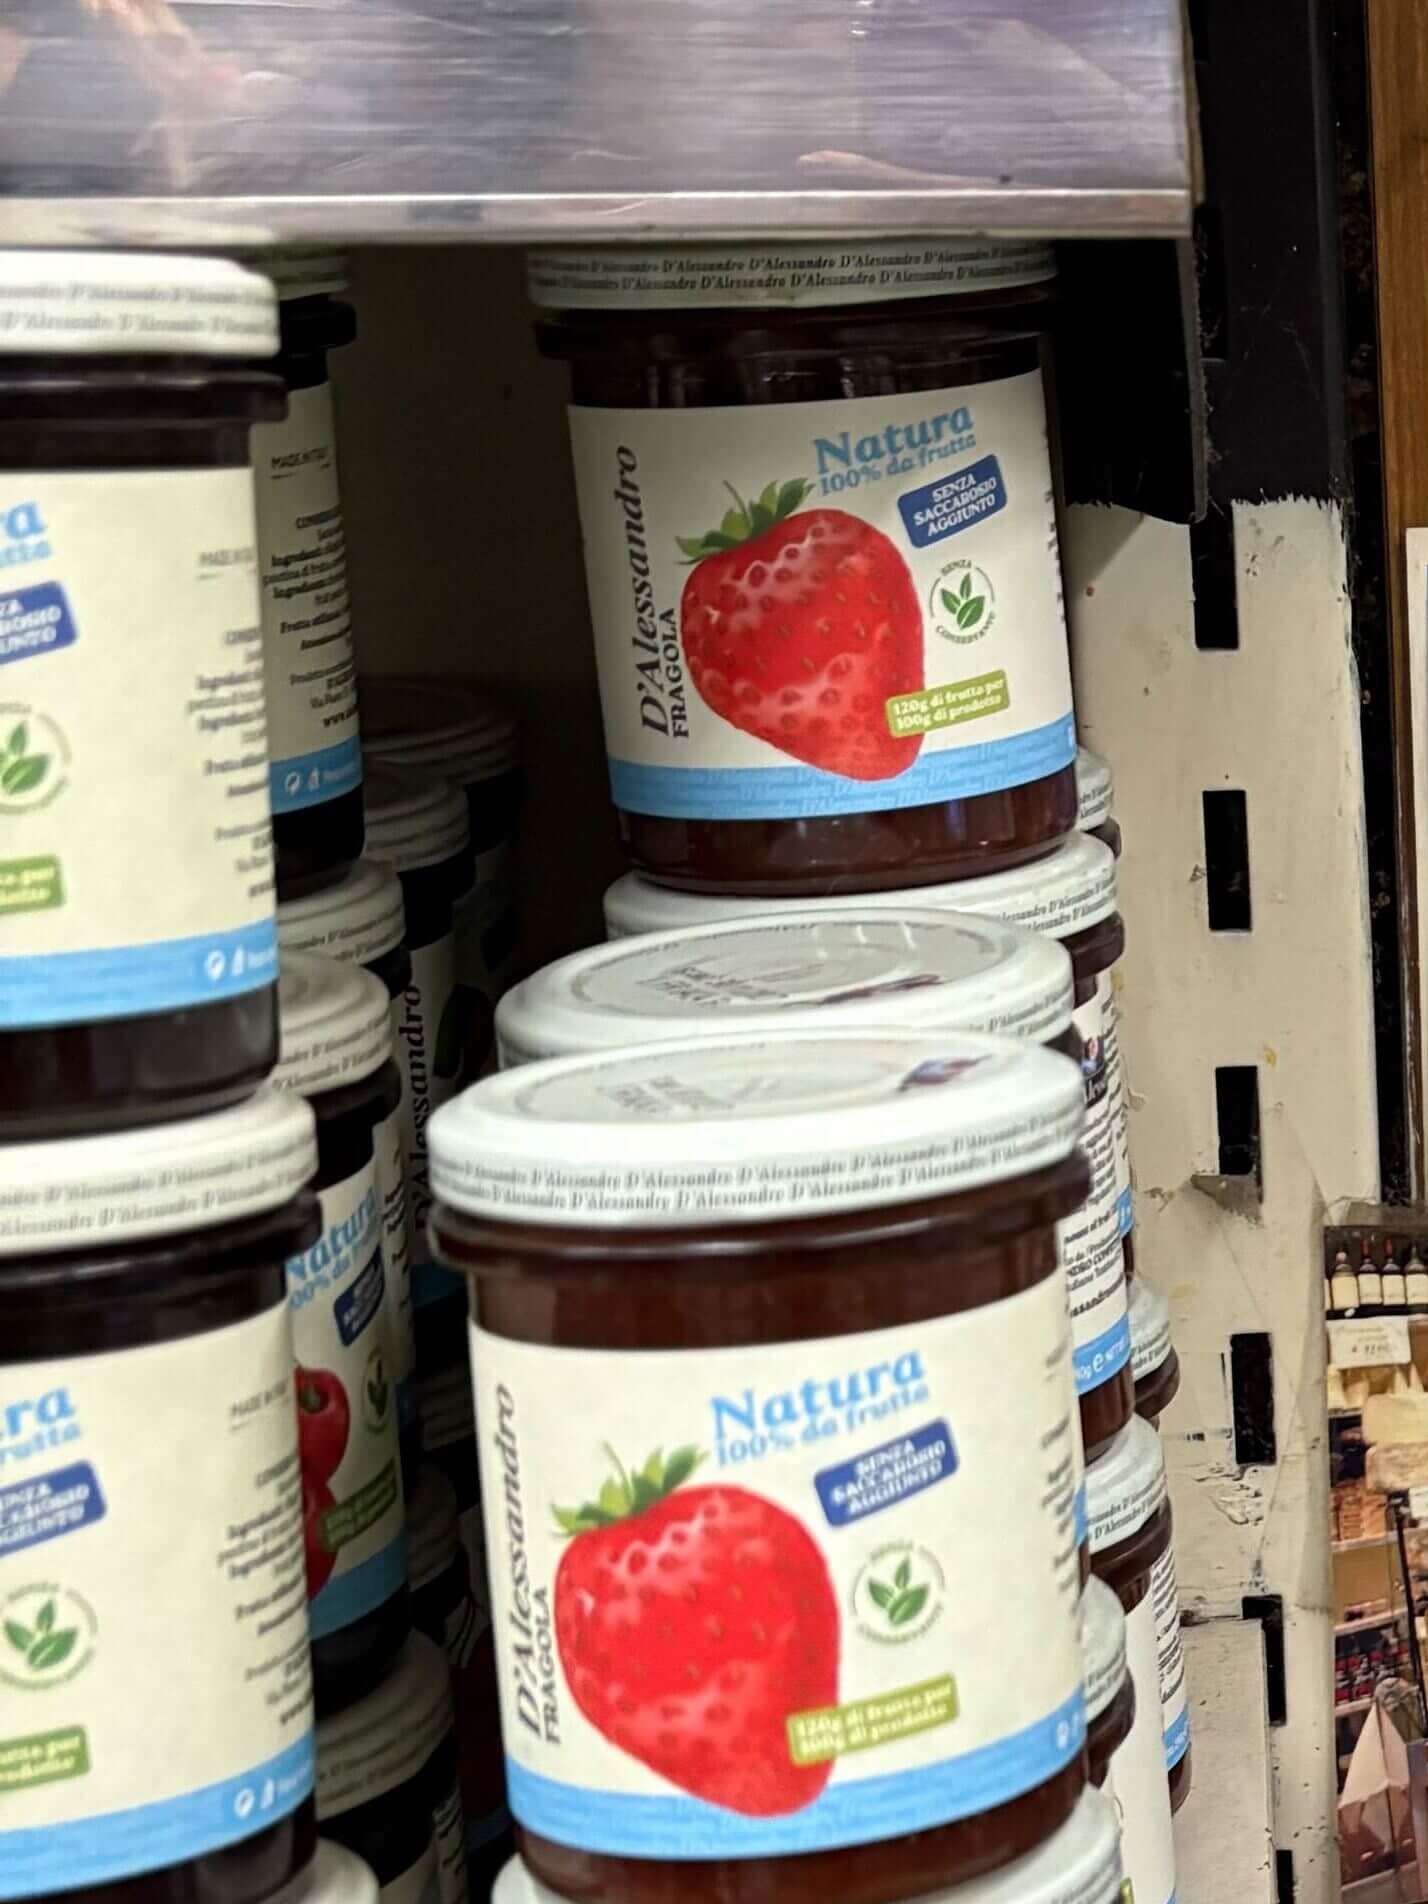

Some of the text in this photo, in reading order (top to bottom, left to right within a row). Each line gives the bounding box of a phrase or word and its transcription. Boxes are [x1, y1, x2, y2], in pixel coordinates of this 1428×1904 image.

[813, 404, 974, 475] Natura
[820, 433, 976, 495] 100% da frutta
[913, 478, 997, 524] SACCAROSIO
[926, 495, 996, 536] AGGIUNTO
[931, 473, 976, 502] SENZA
[665, 608, 689, 738] FRAGOLA
[709, 1352, 925, 1440] Natura
[536, 1585, 561, 1744] FRAGOLA
